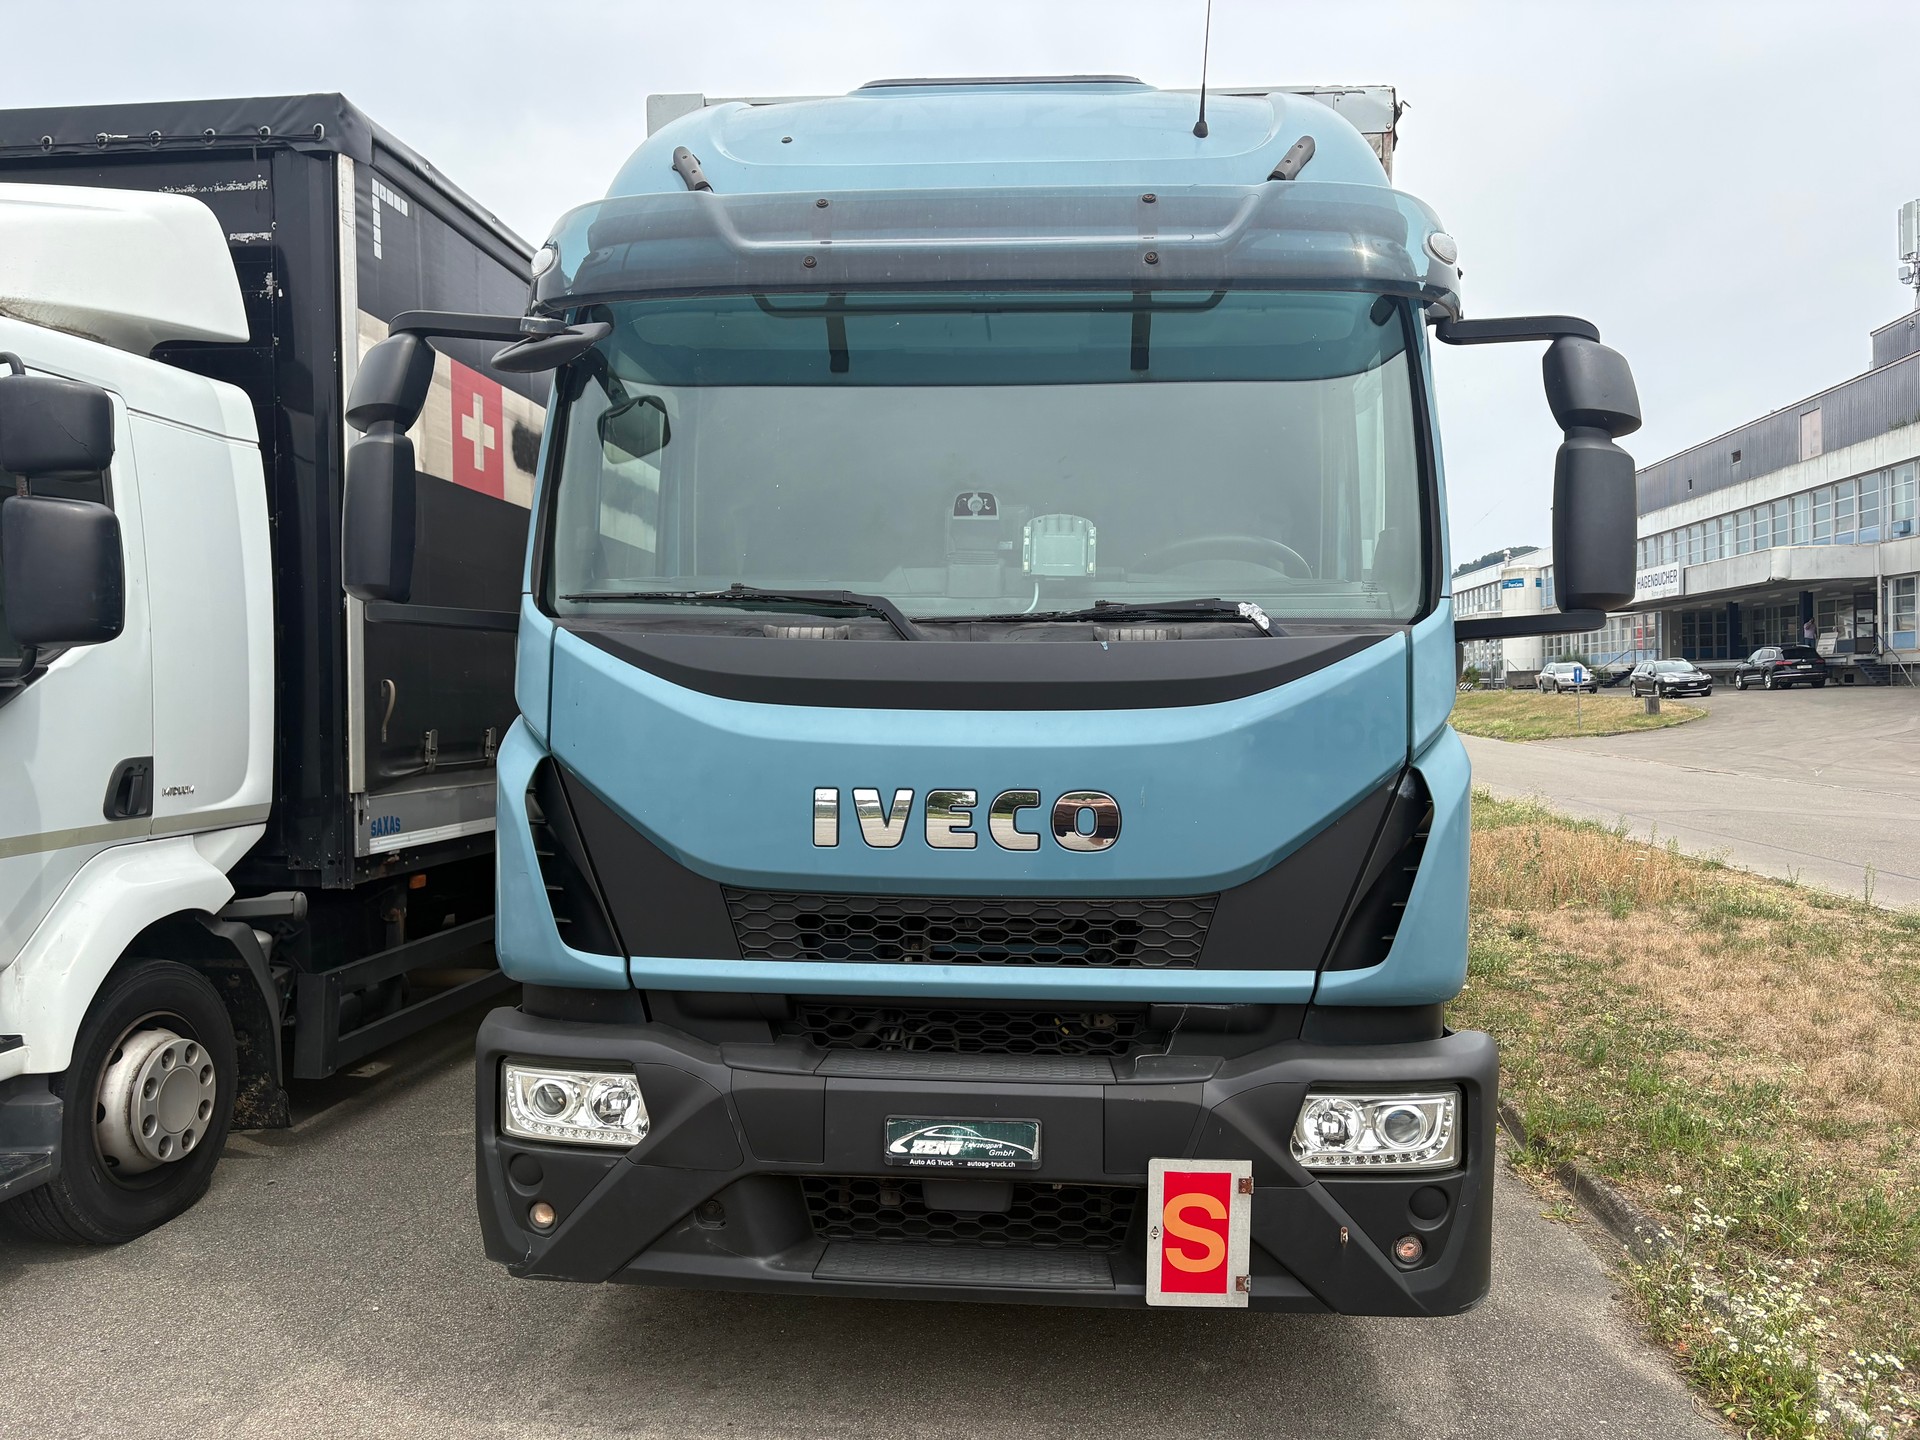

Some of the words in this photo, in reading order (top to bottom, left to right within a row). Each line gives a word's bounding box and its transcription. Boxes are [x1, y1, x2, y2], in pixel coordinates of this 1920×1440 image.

[371, 816, 401, 837] SAXAS
[812, 787, 1122, 852] IVECO
[964, 1141, 1003, 1150] Fahrzeugpark
[988, 1149, 1016, 1157] GmbH
[909, 1158, 925, 1166] Auto
[937, 1159, 954, 1167] Truck
[1163, 1192, 1228, 1273] S
